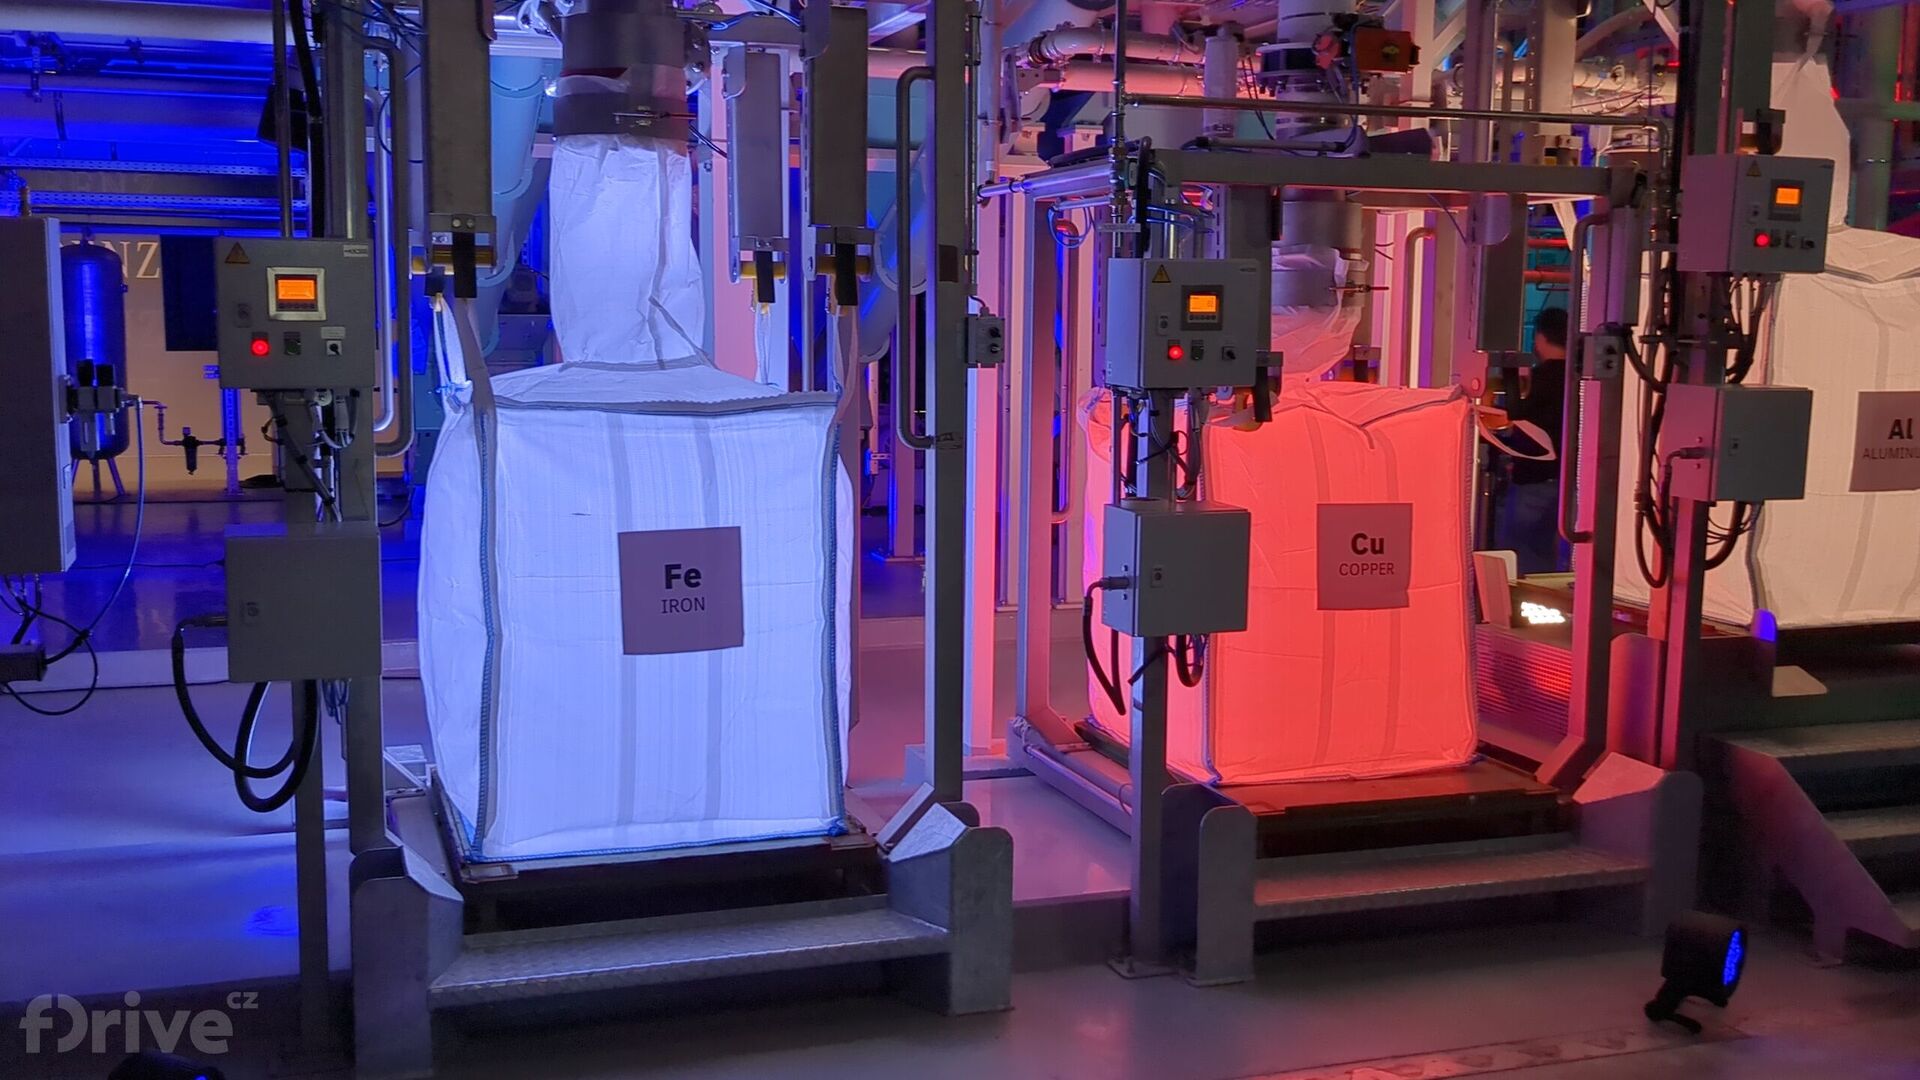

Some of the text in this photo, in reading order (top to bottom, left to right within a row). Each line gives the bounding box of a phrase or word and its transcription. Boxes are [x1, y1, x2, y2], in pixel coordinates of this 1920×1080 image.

[1887, 417, 1914, 440] Al
[1350, 532, 1385, 555] Cu
[663, 563, 703, 590] Fe
[1338, 562, 1395, 577] COPPER
[660, 596, 706, 614] IRON
